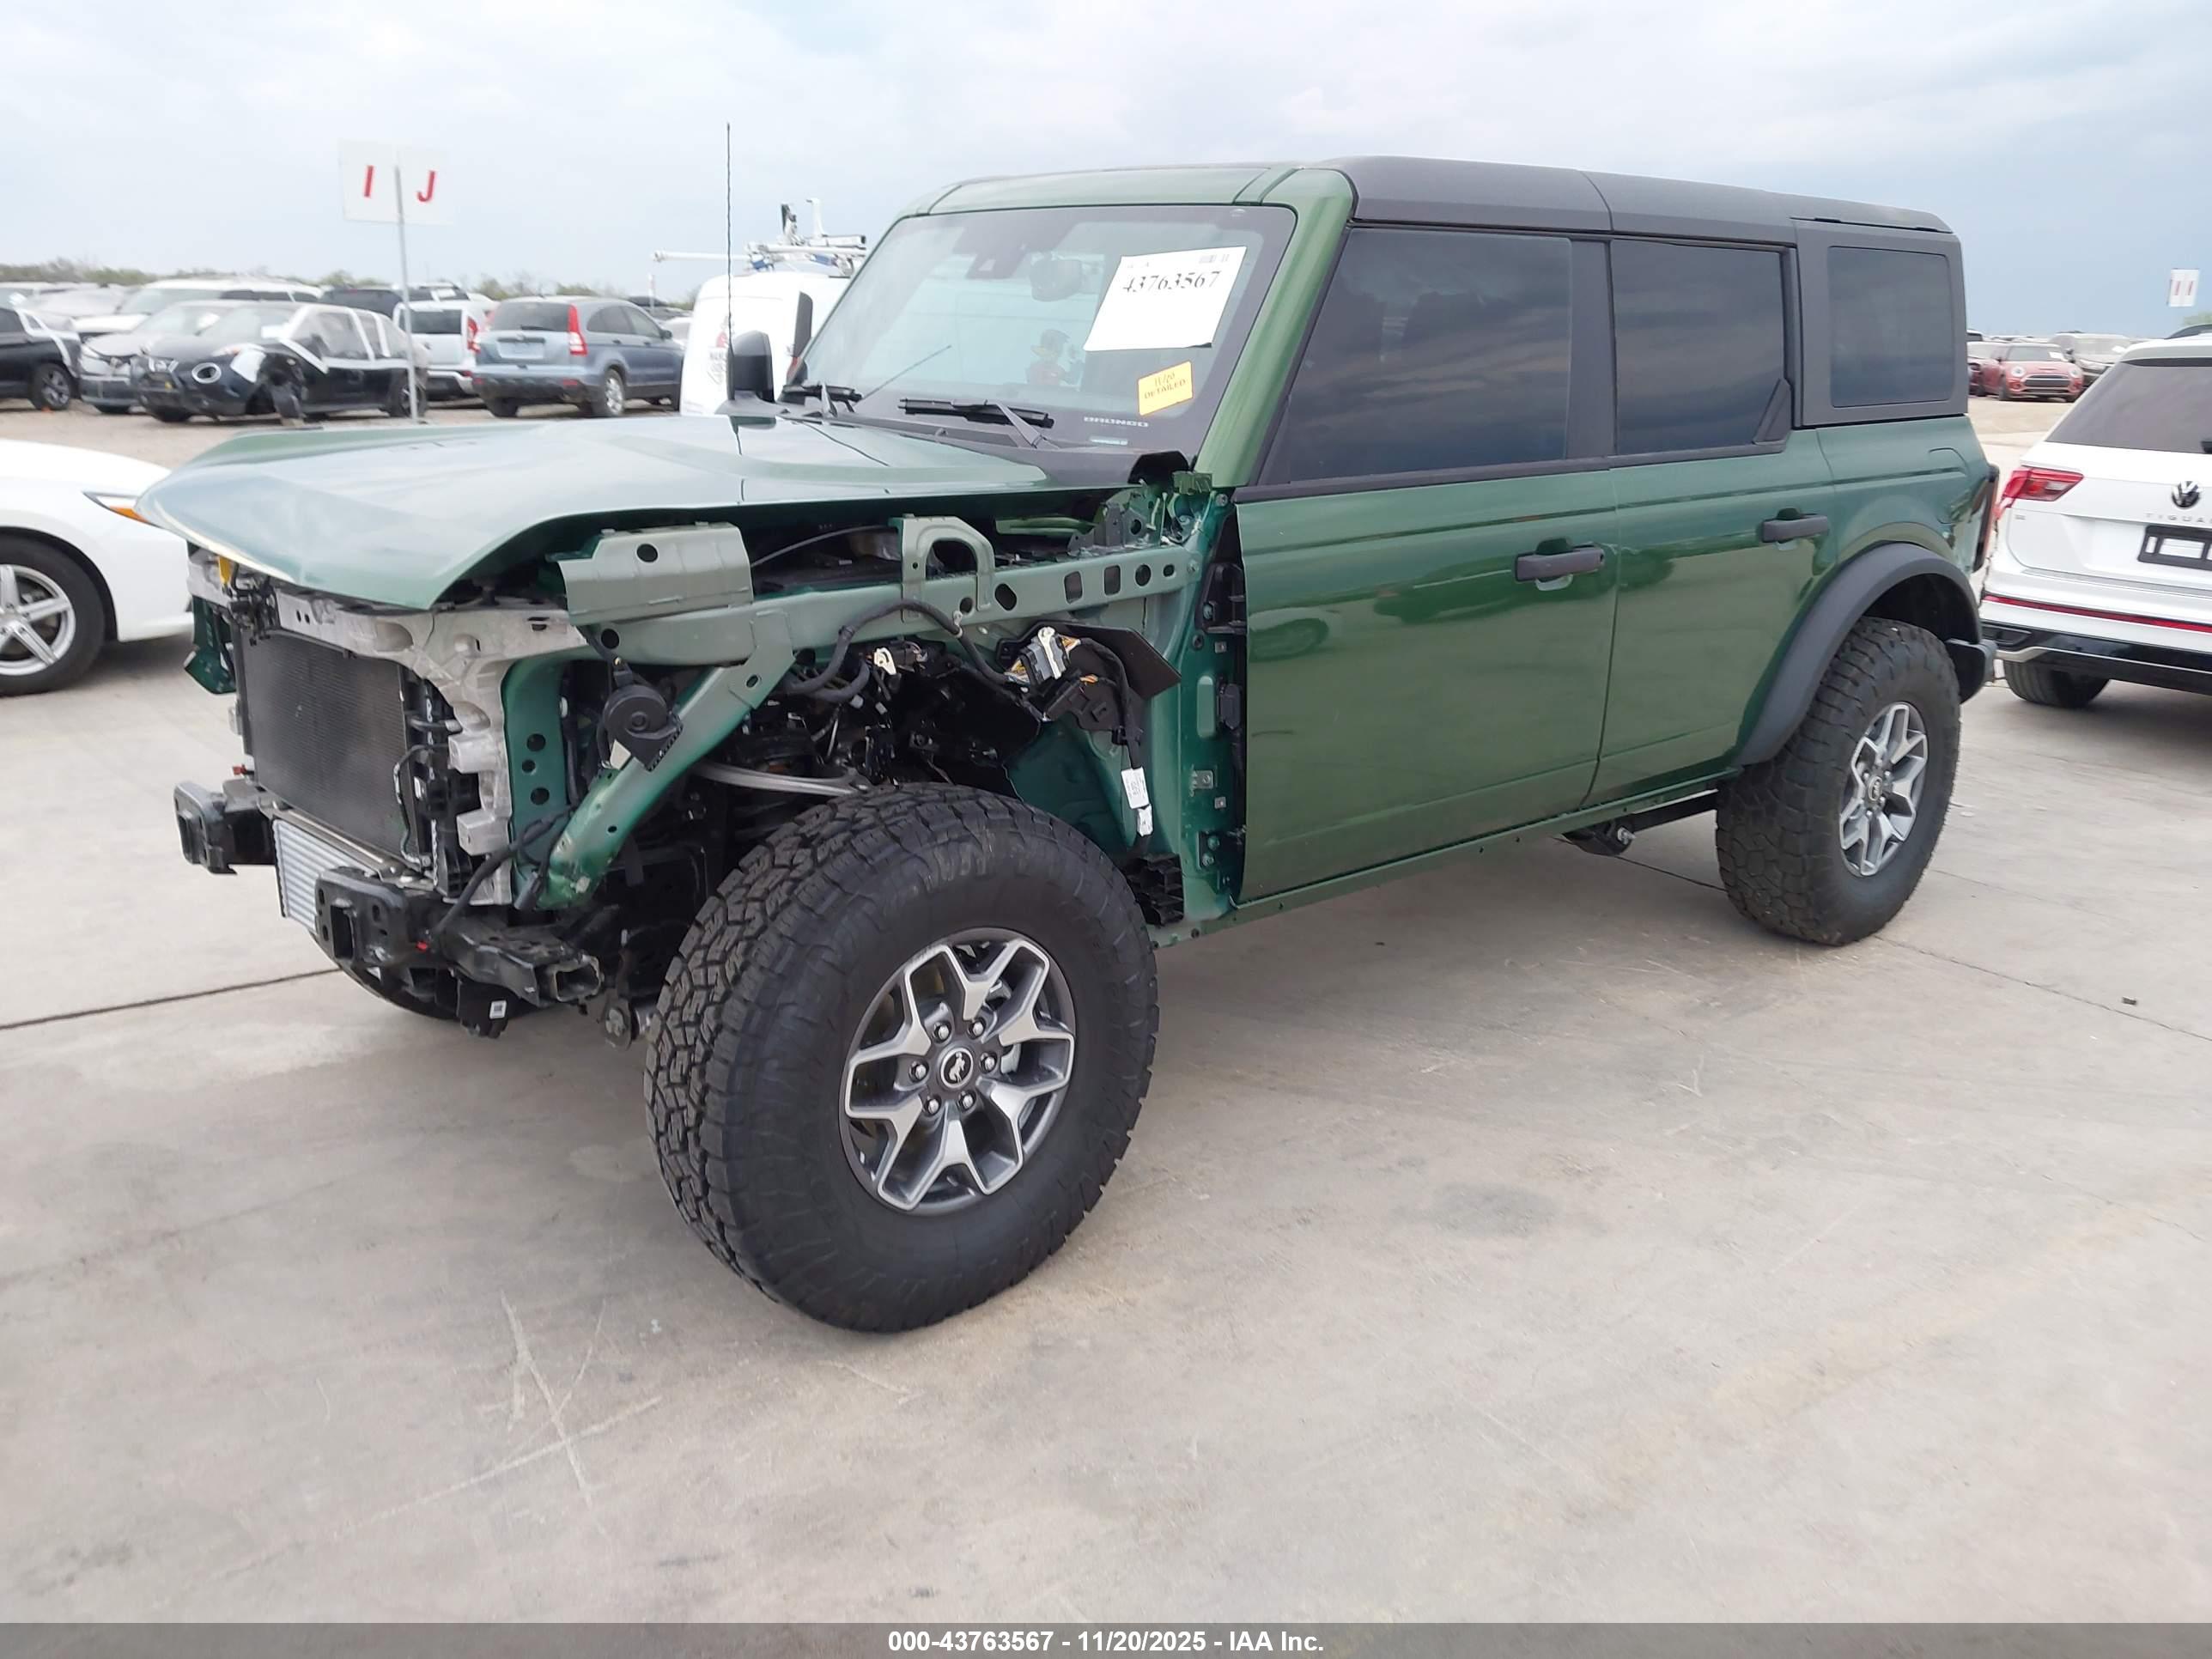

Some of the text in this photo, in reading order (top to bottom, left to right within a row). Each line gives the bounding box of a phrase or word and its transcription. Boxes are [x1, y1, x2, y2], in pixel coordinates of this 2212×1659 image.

[364, 165, 374, 198] I
[416, 170, 435, 203] J
[1122, 270, 1221, 293] 43763567
[2146, 513, 2212, 523] TIGUA
